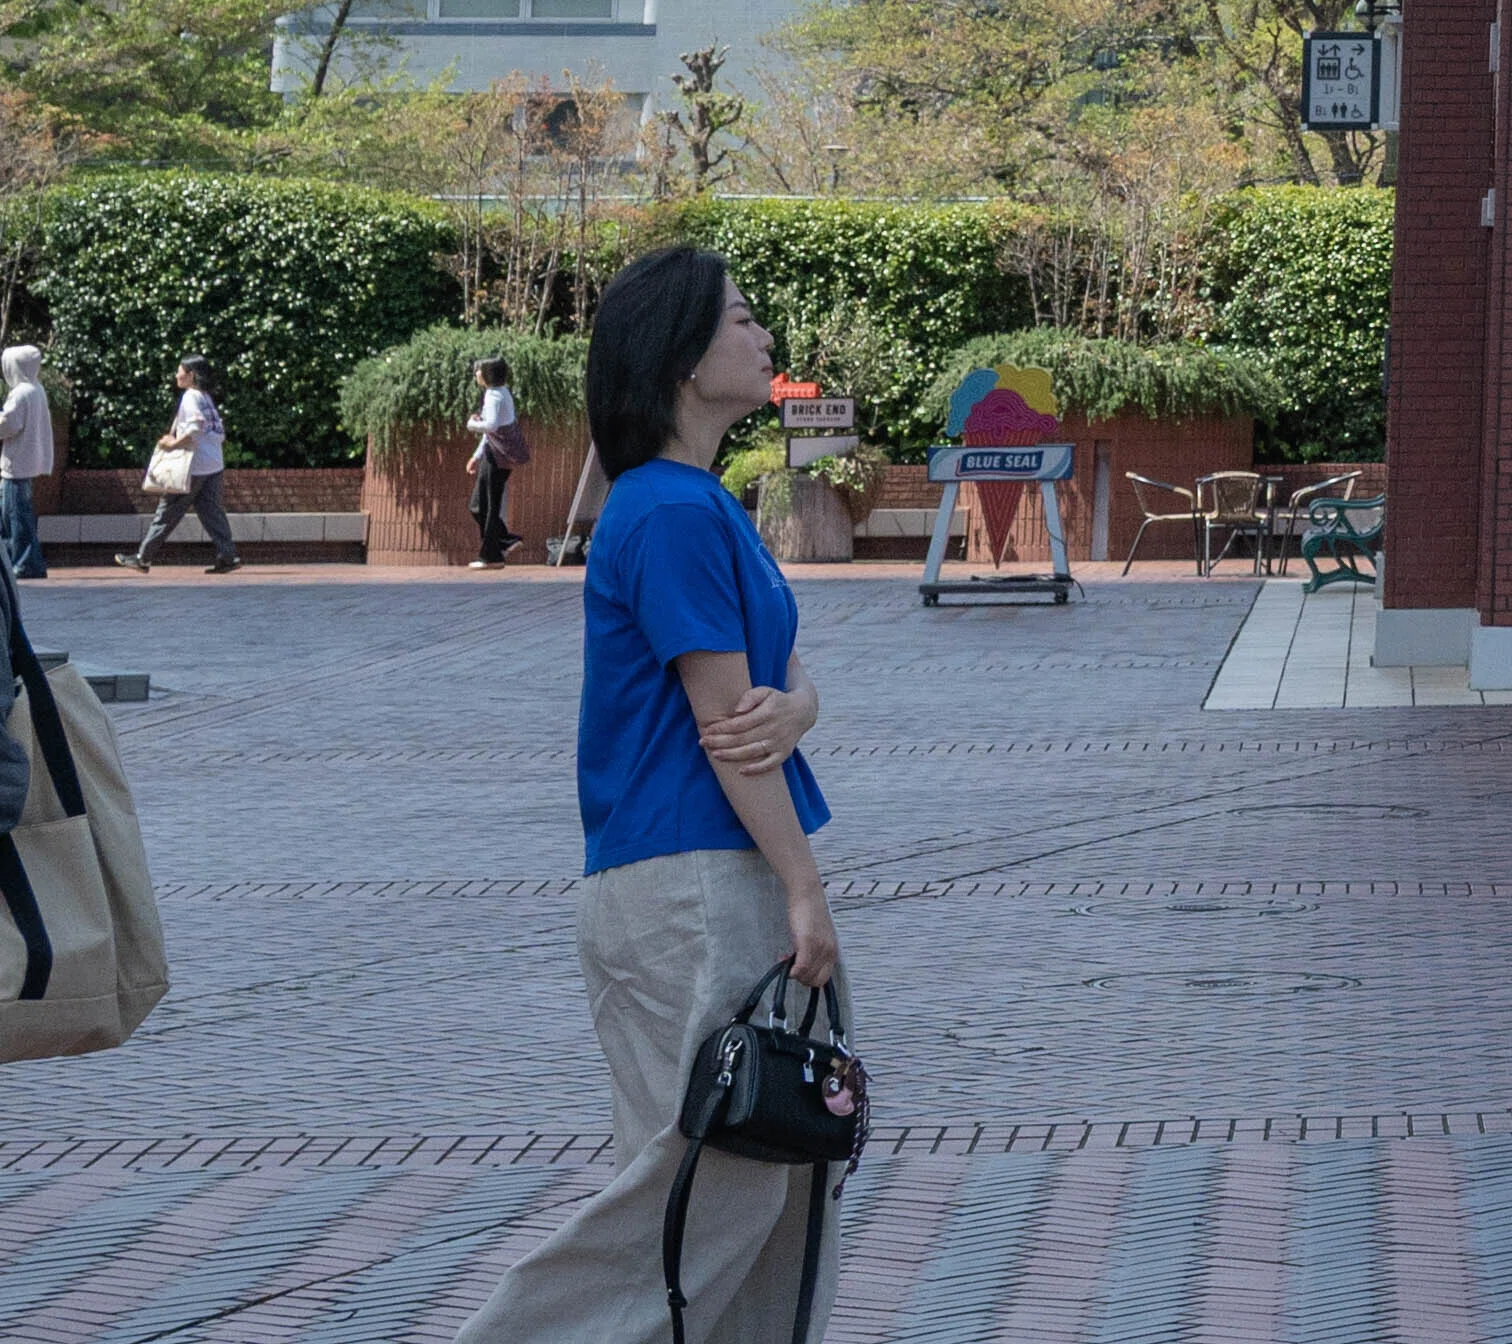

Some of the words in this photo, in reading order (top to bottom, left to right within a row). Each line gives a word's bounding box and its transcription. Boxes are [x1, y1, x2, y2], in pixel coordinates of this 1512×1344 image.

[792, 404, 821, 415] BRICK
[826, 404, 846, 415] END
[966, 455, 1000, 469] BLUE
[1005, 454, 1038, 468] SEAL
